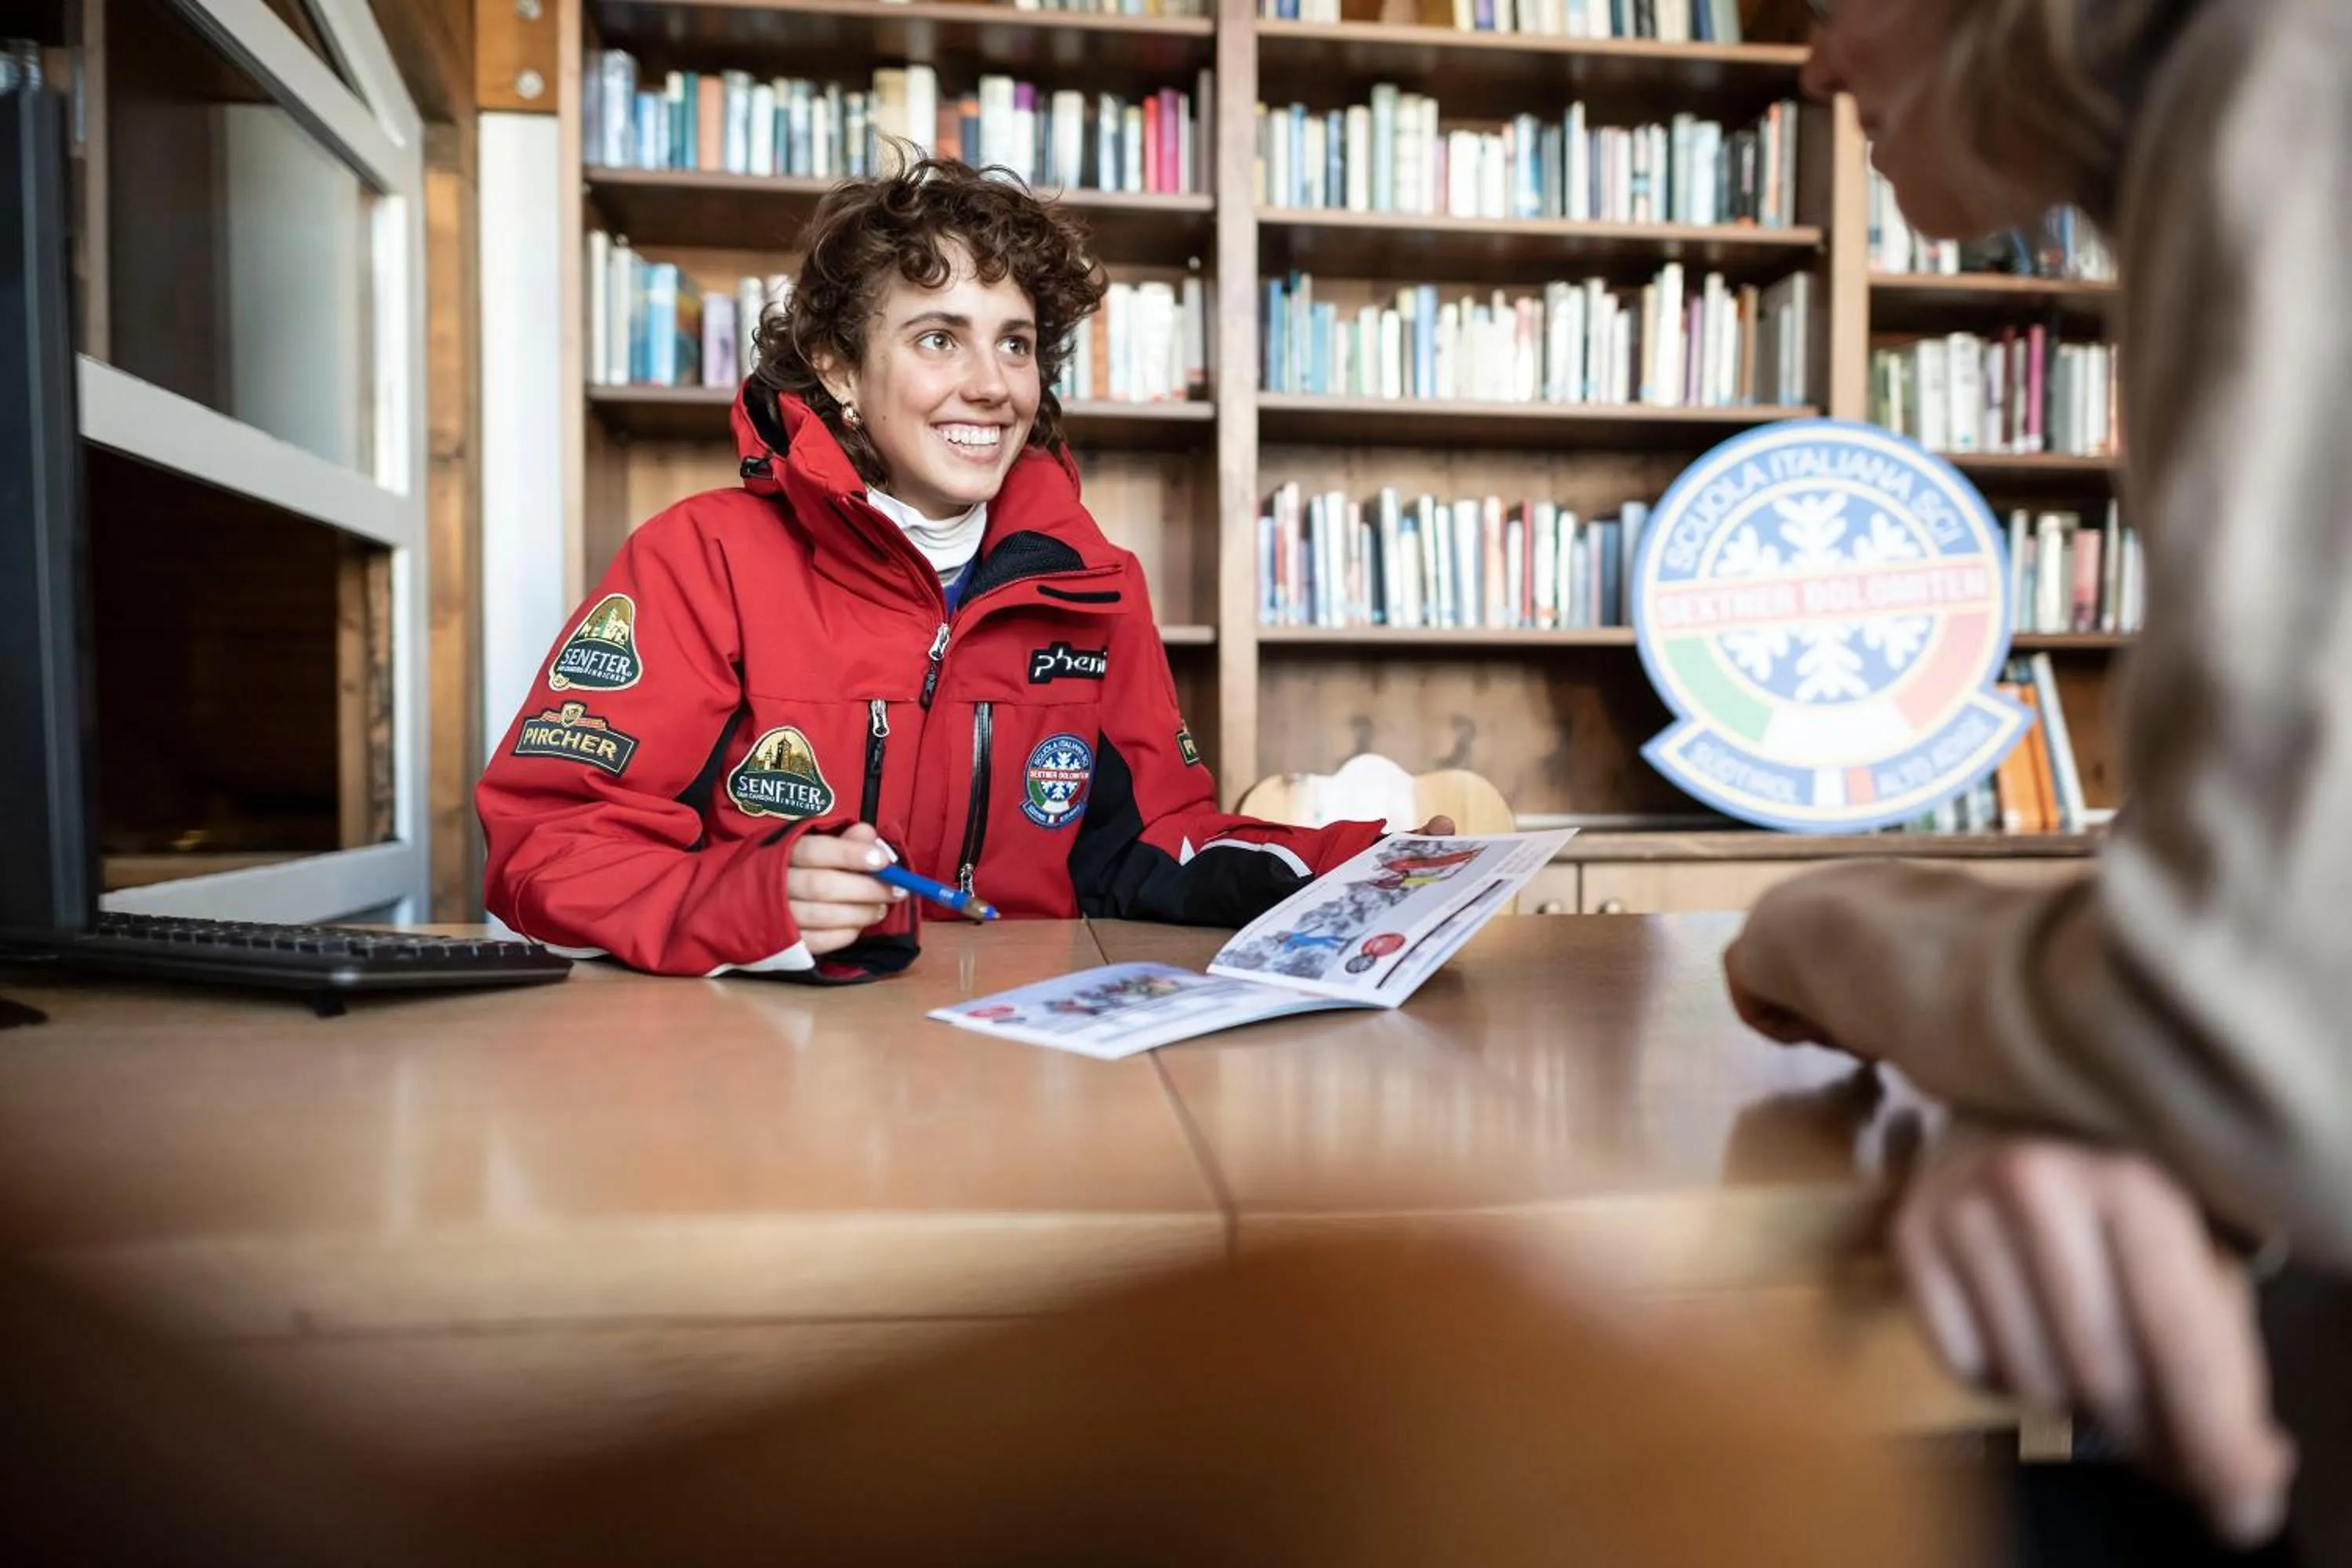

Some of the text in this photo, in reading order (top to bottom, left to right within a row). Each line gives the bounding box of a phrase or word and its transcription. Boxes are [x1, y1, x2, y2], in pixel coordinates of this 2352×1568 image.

[1664, 446, 1965, 572] SCUOLA ITALIANA SCI
[561, 648, 631, 676] SENFTER
[1035, 648, 1108, 678] pheni
[523, 726, 618, 761] PIRCHER
[738, 775, 821, 804] SENFTER
